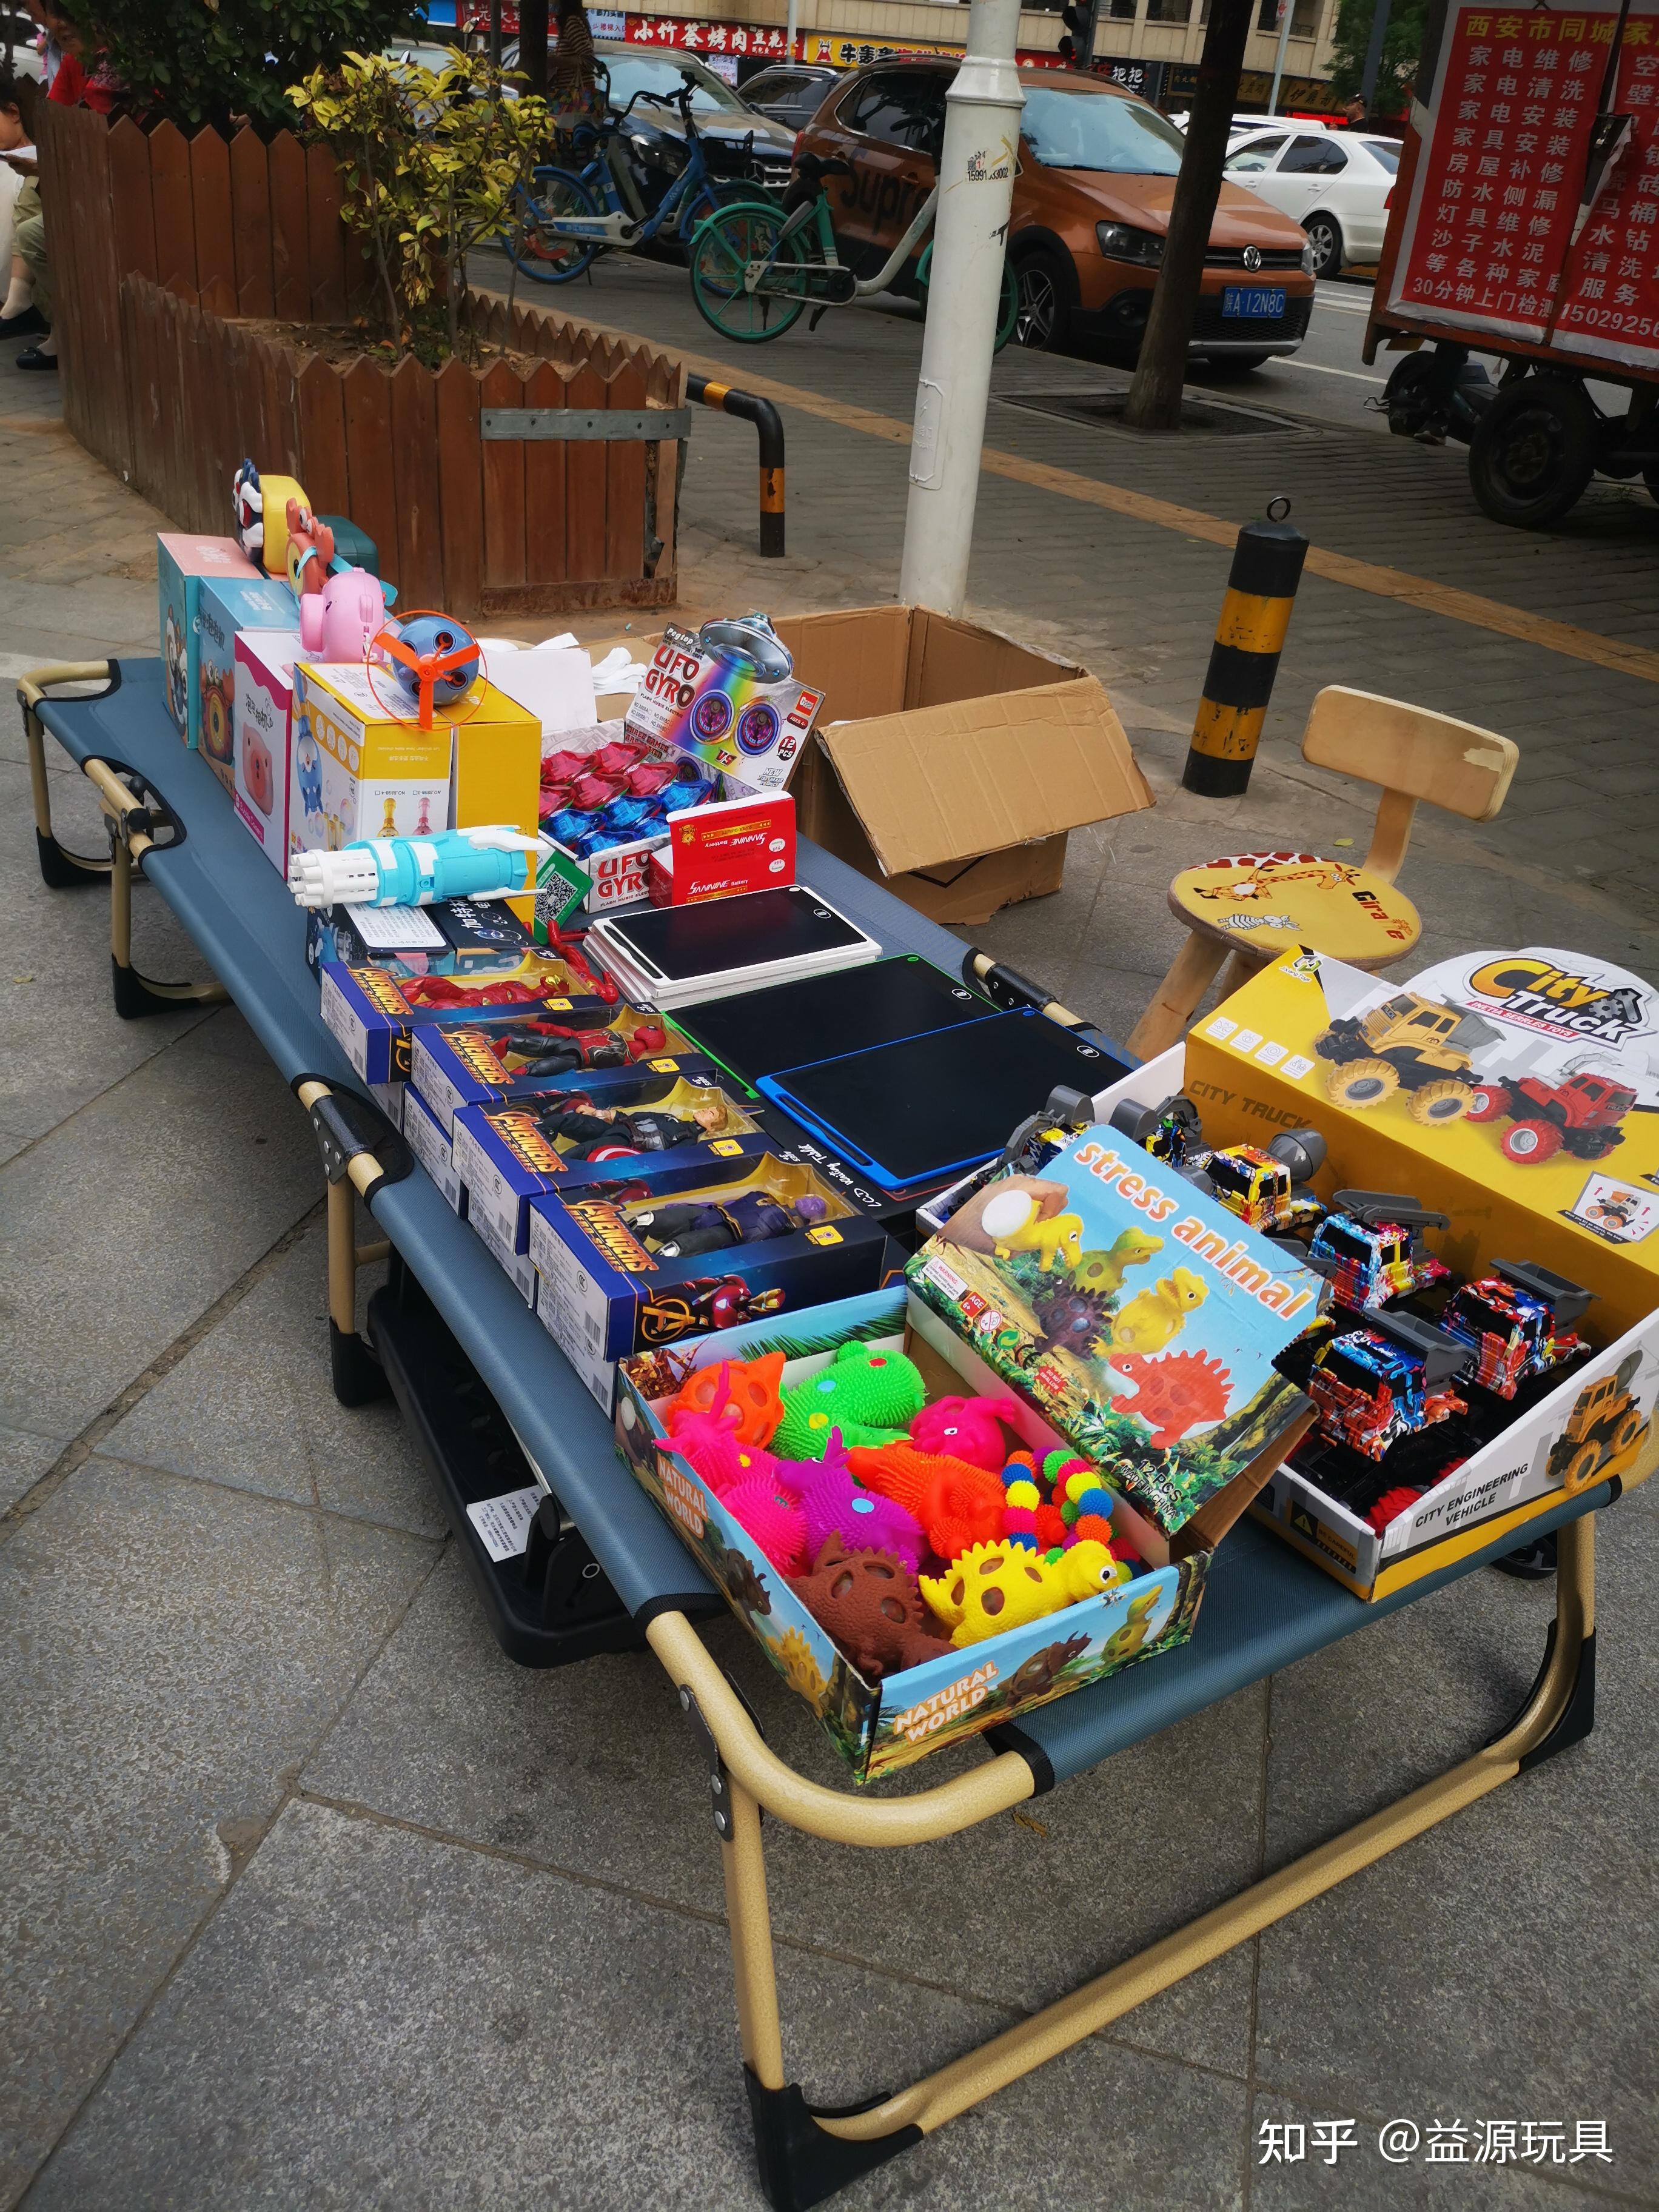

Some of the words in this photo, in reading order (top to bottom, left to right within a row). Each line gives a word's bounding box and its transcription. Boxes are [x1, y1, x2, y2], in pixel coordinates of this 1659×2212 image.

[634, 19, 748, 53] 小竹签烤肉
[1468, 45, 1594, 73] 家电维修
[1463, 73, 1586, 102] 家电清洗
[1458, 99, 1580, 130] 家电安装
[1452, 127, 1572, 158] 家具安装
[1447, 153, 1565, 185] 房屋补修
[1436, 204, 1552, 236] 灯具维修
[1431, 227, 1545, 264] 沙子水泥
[1245, 292, 1284, 313] 12N8C
[1578, 277, 1640, 307] 服务
[654, 643, 700, 681] UFO
[645, 668, 696, 709] GYRO
[789, 714, 802, 725] AGES
[714, 748, 737, 767] VS
[777, 748, 793, 759] PCS
[782, 737, 796, 750] 12
[762, 767, 783, 777] NEW
[704, 839, 728, 848] Battery
[617, 896, 634, 904] MUSIC
[350, 967, 414, 1016] AVENGERS
[1471, 958, 1611, 1008] City
[1471, 1001, 1503, 1017] INETIA
[1503, 1008, 1547, 1030] SERRLES
[1546, 1024, 1575, 1038] TOYS
[1506, 990, 1641, 1042] Truck
[441, 1030, 515, 1084] AVENGERS
[1188, 1079, 1239, 1106] CITY
[1242, 1096, 1314, 1130] TRUCK
[485, 1111, 568, 1173] AVENGERS
[853, 1187, 882, 1208] LCD
[564, 1200, 660, 1272] AVENGERS
[1073, 1139, 1180, 1223] stress
[1170, 1215, 1318, 1321] animal
[962, 1301, 971, 1310] 6+
[969, 1295, 985, 1310] AGE
[1039, 1371, 1060, 1391] SWALLOW
[1045, 1368, 1054, 1376] DO
[1050, 1373, 1062, 1384] NOT
[1120, 1464, 1141, 1484] MADE
[1148, 1486, 1178, 1520] CHINA
[1137, 1458, 1155, 1475] 12
[1151, 1469, 1183, 1503] PCS
[1415, 1506, 1444, 1528] CITY
[1446, 1463, 1529, 1512] ENGINEERING
[1445, 1492, 1496, 1527] VEHICLE
[1327, 1533, 1356, 1561] CAREFUL
[894, 1660, 999, 1735] NATURAL
[904, 1686, 990, 1742] WORLD
